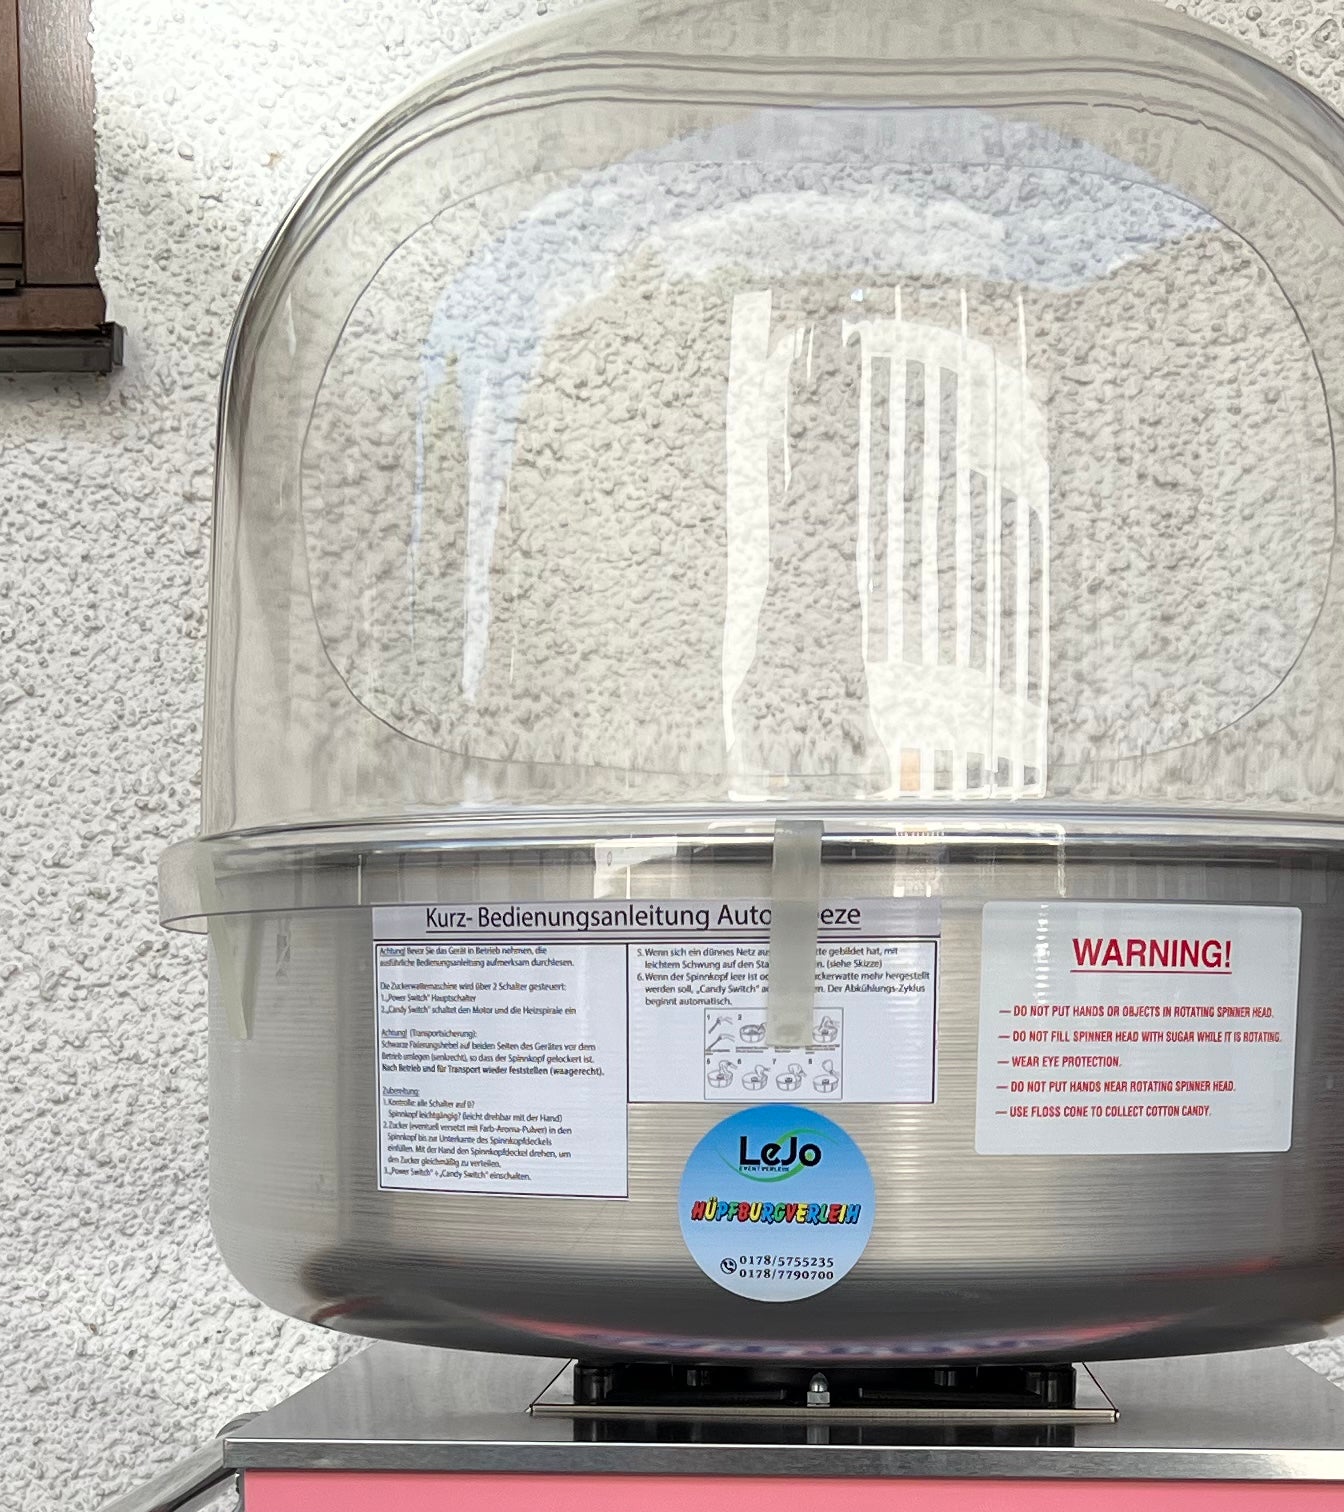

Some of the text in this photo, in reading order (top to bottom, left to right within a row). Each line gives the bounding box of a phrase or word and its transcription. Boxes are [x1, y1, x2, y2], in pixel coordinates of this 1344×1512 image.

[426, 908, 472, 928] Kurz-
[479, 906, 709, 930] Bedienungsanleitung
[448, 946, 466, 954] Gerät
[476, 946, 500, 954] Betrieb
[502, 947, 534, 955] nehmen,
[829, 947, 863, 957] gebildet
[866, 947, 882, 955] hat,
[884, 947, 897, 955] mit
[1072, 938, 1232, 968] WARNING!
[417, 958, 574, 968] Bedienungsanleitung aufmerksam durchlesen.
[645, 961, 680, 969] leichtem
[682, 961, 720, 970] Schwung
[723, 960, 737, 968] auf
[827, 960, 851, 968] (siehe
[854, 959, 882, 968] Skizze)
[637, 973, 644, 981] 6.
[645, 973, 668, 981] Wenn
[686, 973, 728, 982] Spinnkopf
[861, 972, 883, 980] mehr
[886, 972, 930, 981] hergestellt
[380, 982, 390, 990] Die
[499, 983, 527, 991] Schalter
[645, 985, 675, 993] werden
[678, 985, 693, 994] soll,
[844, 984, 925, 994] Abkühlungs-Zyklus
[432, 994, 476, 1002] Hauptschalter
[645, 998, 732, 1007] beginnt automatisch.
[473, 1006, 492, 1014] Motor
[495, 1006, 508, 1014] und
[510, 1006, 521, 1014] die
[523, 1006, 562, 1016] Heizspirale
[1014, 1006, 1274, 1018] DO NOT PUT HANDS OR OBJECTS IN ROTATING SPINNER HEAD.
[1013, 1031, 1281, 1043] DO NOT FILL SPINNER HEAD WITH SUGAR WHILE IT IS ROTATING.
[460, 1041, 470, 1049] auf
[497, 1042, 519, 1050] Seiten
[520, 1042, 533, 1050] des
[534, 1042, 562, 1050] Gerätes
[578, 1043, 596, 1051] dem
[382, 1052, 402, 1060] Betrieb
[478, 1053, 493, 1061] dass
[495, 1054, 506, 1062] der
[508, 1054, 545, 1064] Spinnkopf
[546, 1055, 581, 1064] gelockert
[1012, 1056, 1122, 1067] WEAR EYE PROTECTION.
[399, 1064, 421, 1072] Betrieb
[448, 1065, 481, 1074] Transport
[509, 1066, 548, 1075] feststellen
[550, 1067, 605, 1076] (waagerecht).
[1011, 1081, 1236, 1092] DO NOT PUT HANDS NEAR ROTATING SPINNER HEAD.
[1010, 1106, 1211, 1117] USE FLOSS CONE TO COLLECT COTTON CANDY.
[439, 1134, 475, 1143] Unterkante
[438, 1146, 455, 1154] Hand
[457, 1146, 469, 1154] den
[529, 1149, 557, 1158] drehen,
[739, 1135, 821, 1166] LeJo
[401, 1156, 419, 1164] Zucker
[691, 1196, 862, 1225] HÜPFBURGVERLEIH
[740, 1255, 834, 1268] 0178/5755235
[740, 1269, 834, 1280] 0178/7790700
